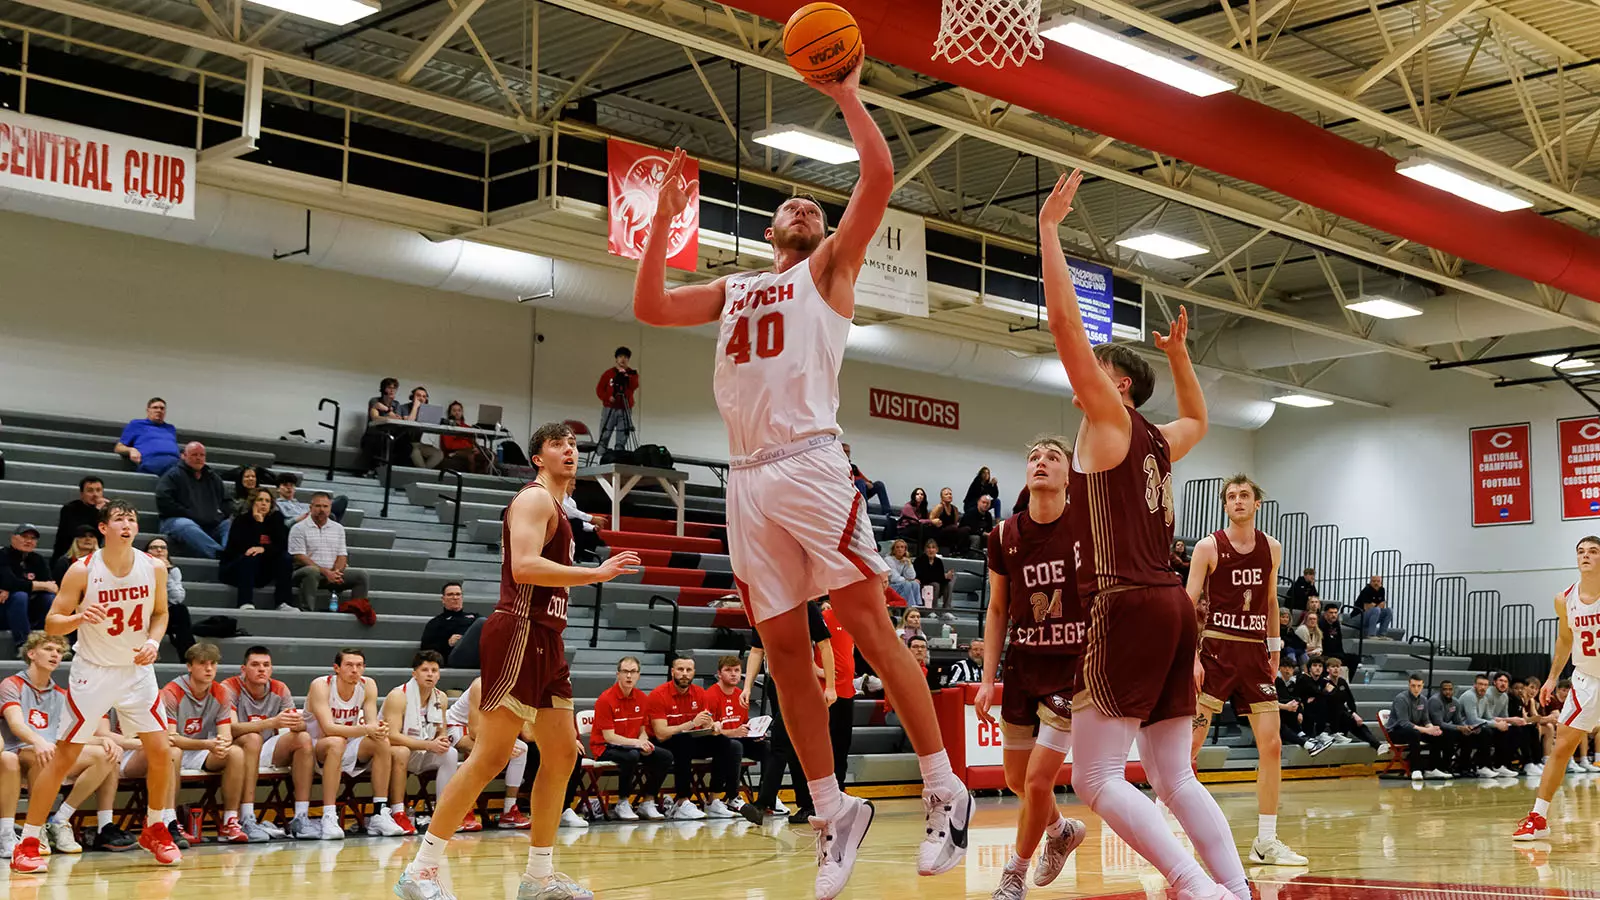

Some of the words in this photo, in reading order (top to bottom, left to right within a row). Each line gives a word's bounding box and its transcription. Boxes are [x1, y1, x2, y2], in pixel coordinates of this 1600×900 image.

[808, 40, 845, 66] NCAA
[0, 122, 113, 192] CENTRAL
[124, 149, 185, 204] CLUB
[864, 258, 918, 278] AMSTERDAM
[725, 311, 784, 365] 40
[873, 392, 956, 426] VISITORS
[1479, 460, 1523, 472] CHAMPIONS
[1483, 452, 1519, 462] NATIONAL
[1482, 477, 1521, 489] FOOTBALL
[1491, 494, 1514, 506] 1974
[1580, 487, 1600, 499] 198
[1023, 560, 1065, 588] COE
[1231, 568, 1262, 586] COE
[98, 585, 149, 604] DUTCH
[1243, 589, 1252, 612] 1
[104, 603, 144, 637] 34
[1213, 612, 1266, 631] COLLEGE
[725, 706, 733, 716] C
